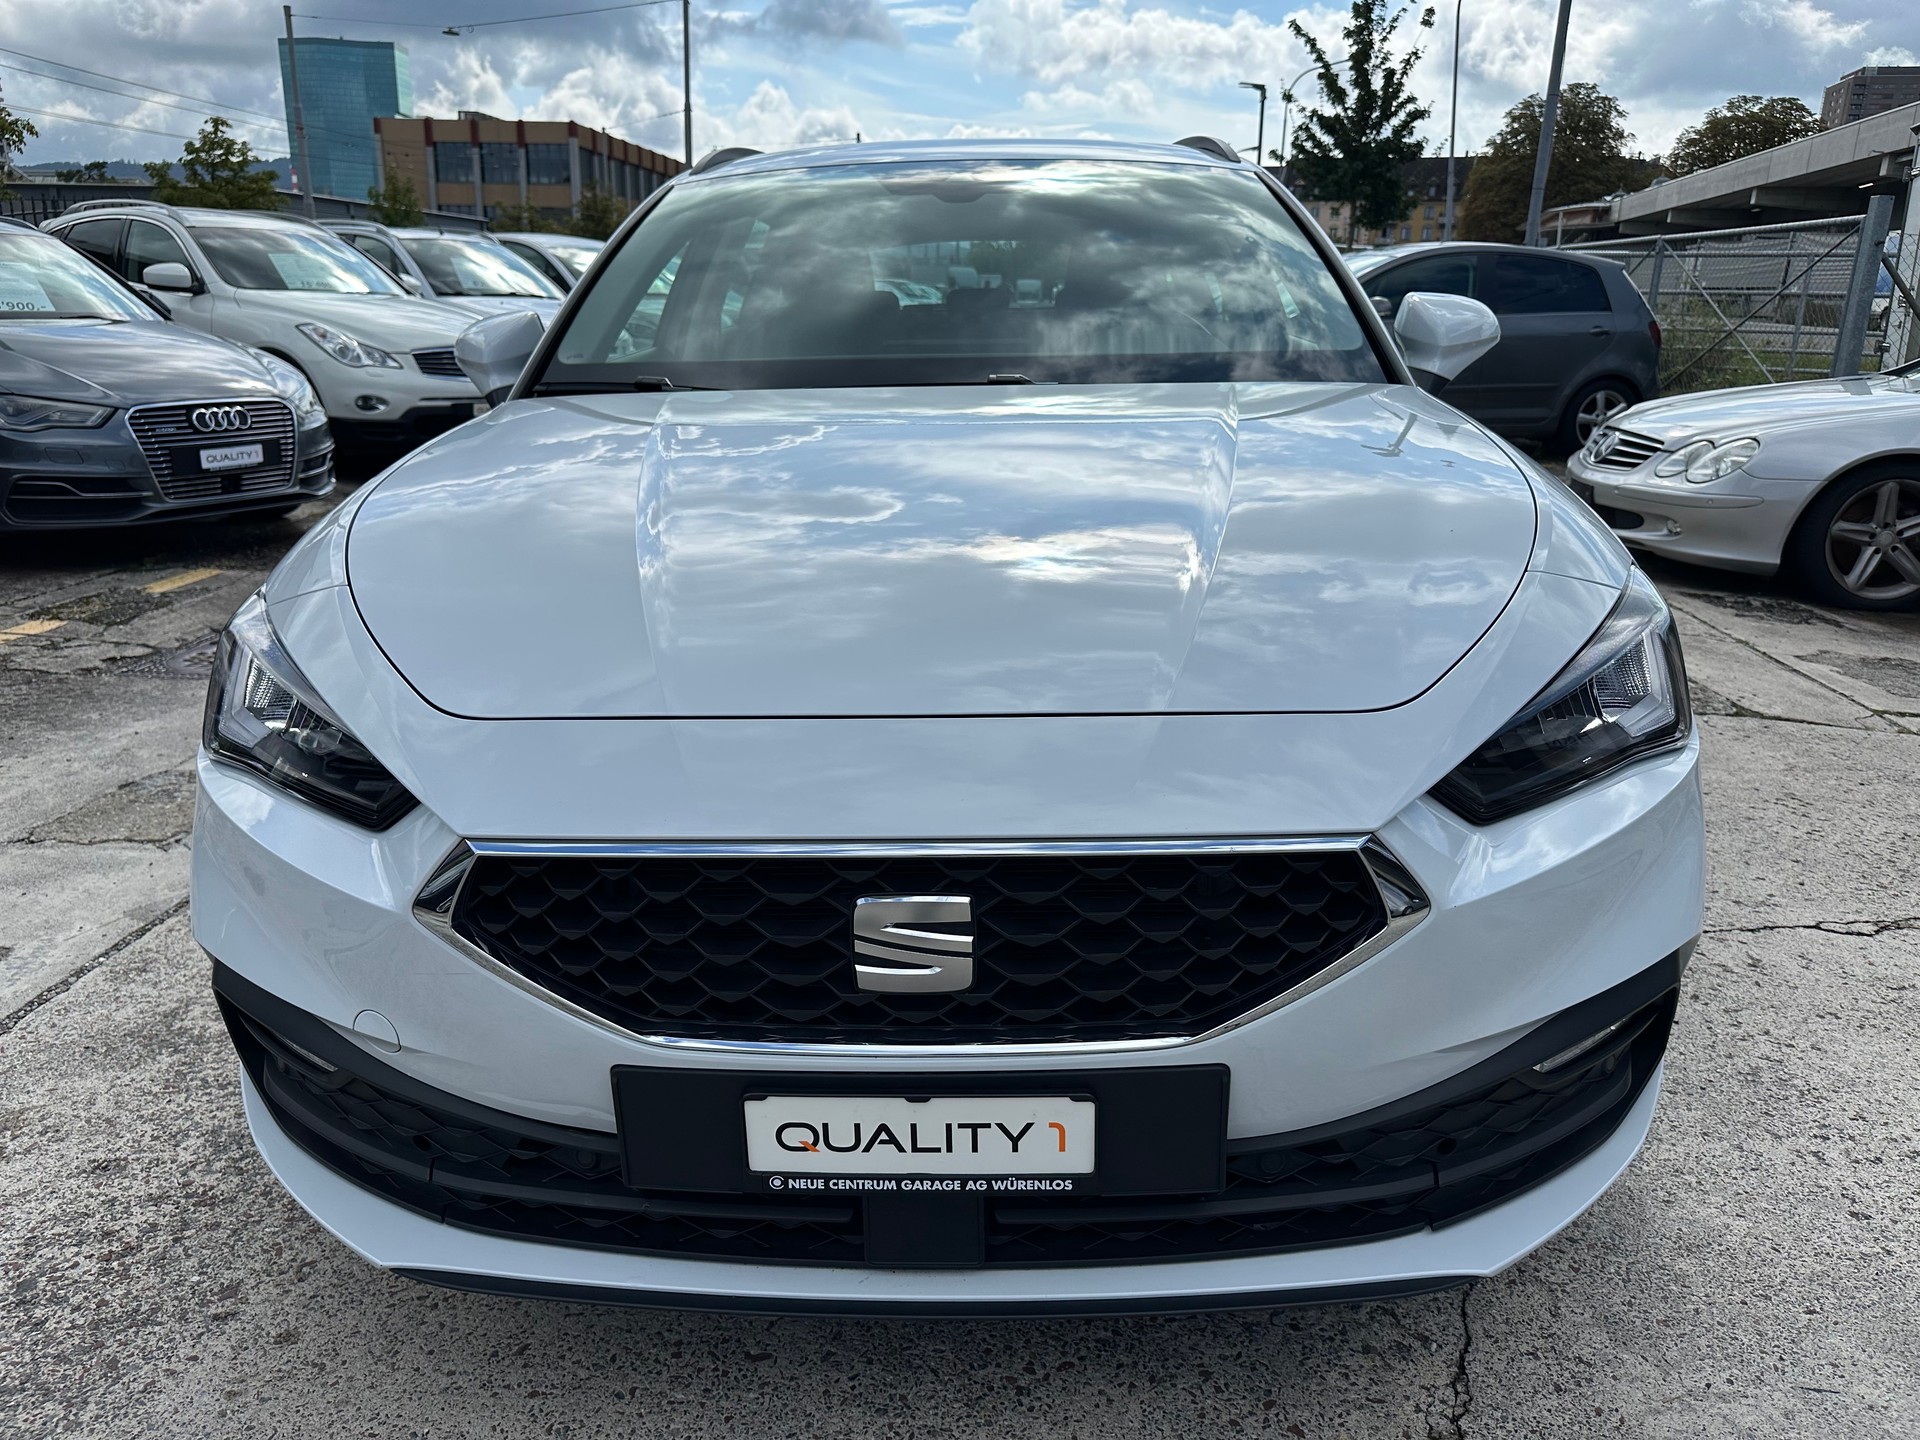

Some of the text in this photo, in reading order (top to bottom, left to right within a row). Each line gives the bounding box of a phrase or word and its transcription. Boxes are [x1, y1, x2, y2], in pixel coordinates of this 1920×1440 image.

[206, 451, 253, 463] QUALITY
[775, 1122, 1066, 1153] QUALITY 1
[788, 1177, 1073, 1191] NEUE CENTRUM GARAGE AG WÜRENLOS
